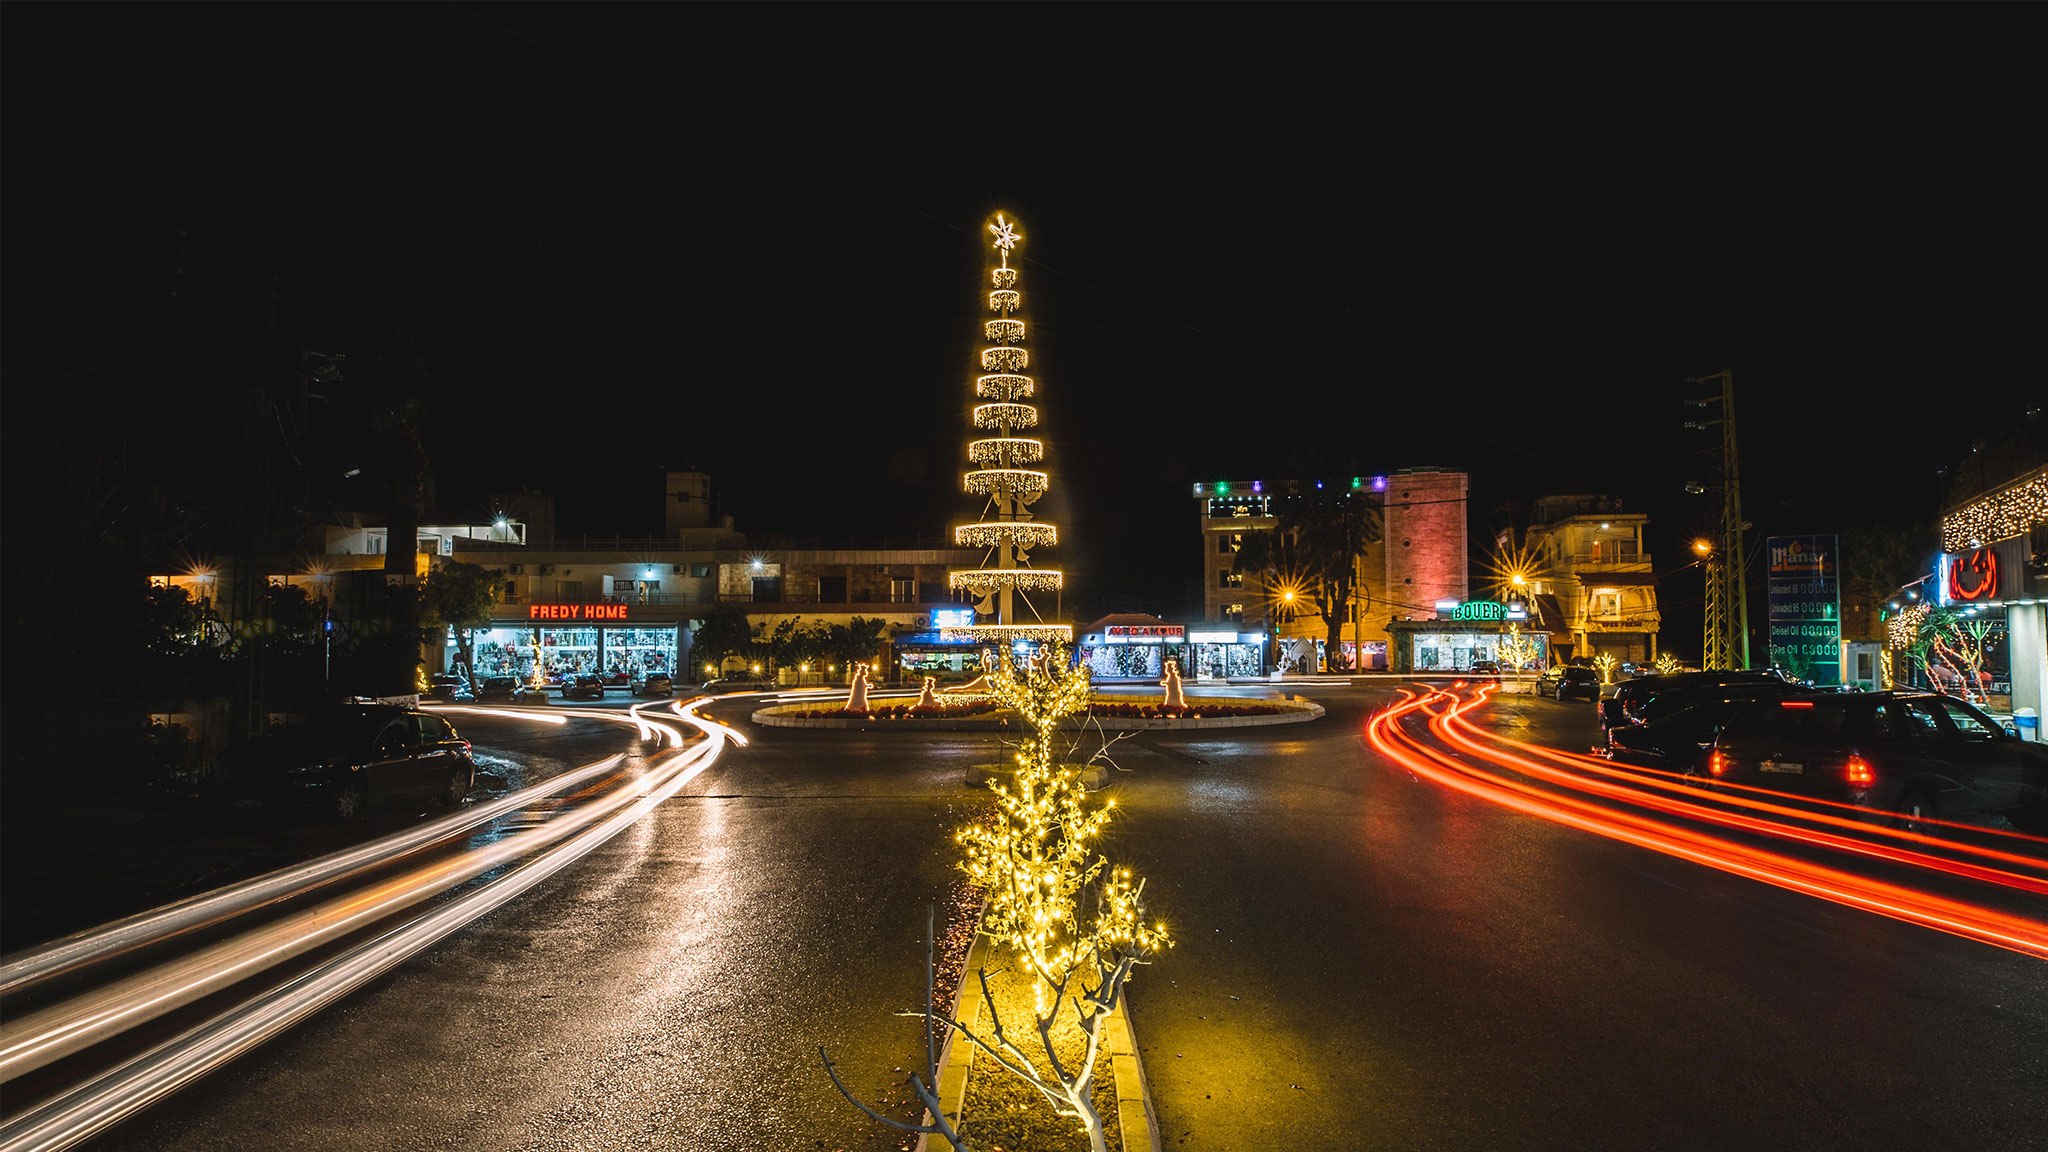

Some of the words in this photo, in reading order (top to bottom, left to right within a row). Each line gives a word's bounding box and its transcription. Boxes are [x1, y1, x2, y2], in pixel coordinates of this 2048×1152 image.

[530, 605, 580, 619] FREDY
[585, 605, 628, 619] HOME
[1108, 627, 1138, 637] AVEC
[1772, 644, 1786, 655] Gas
